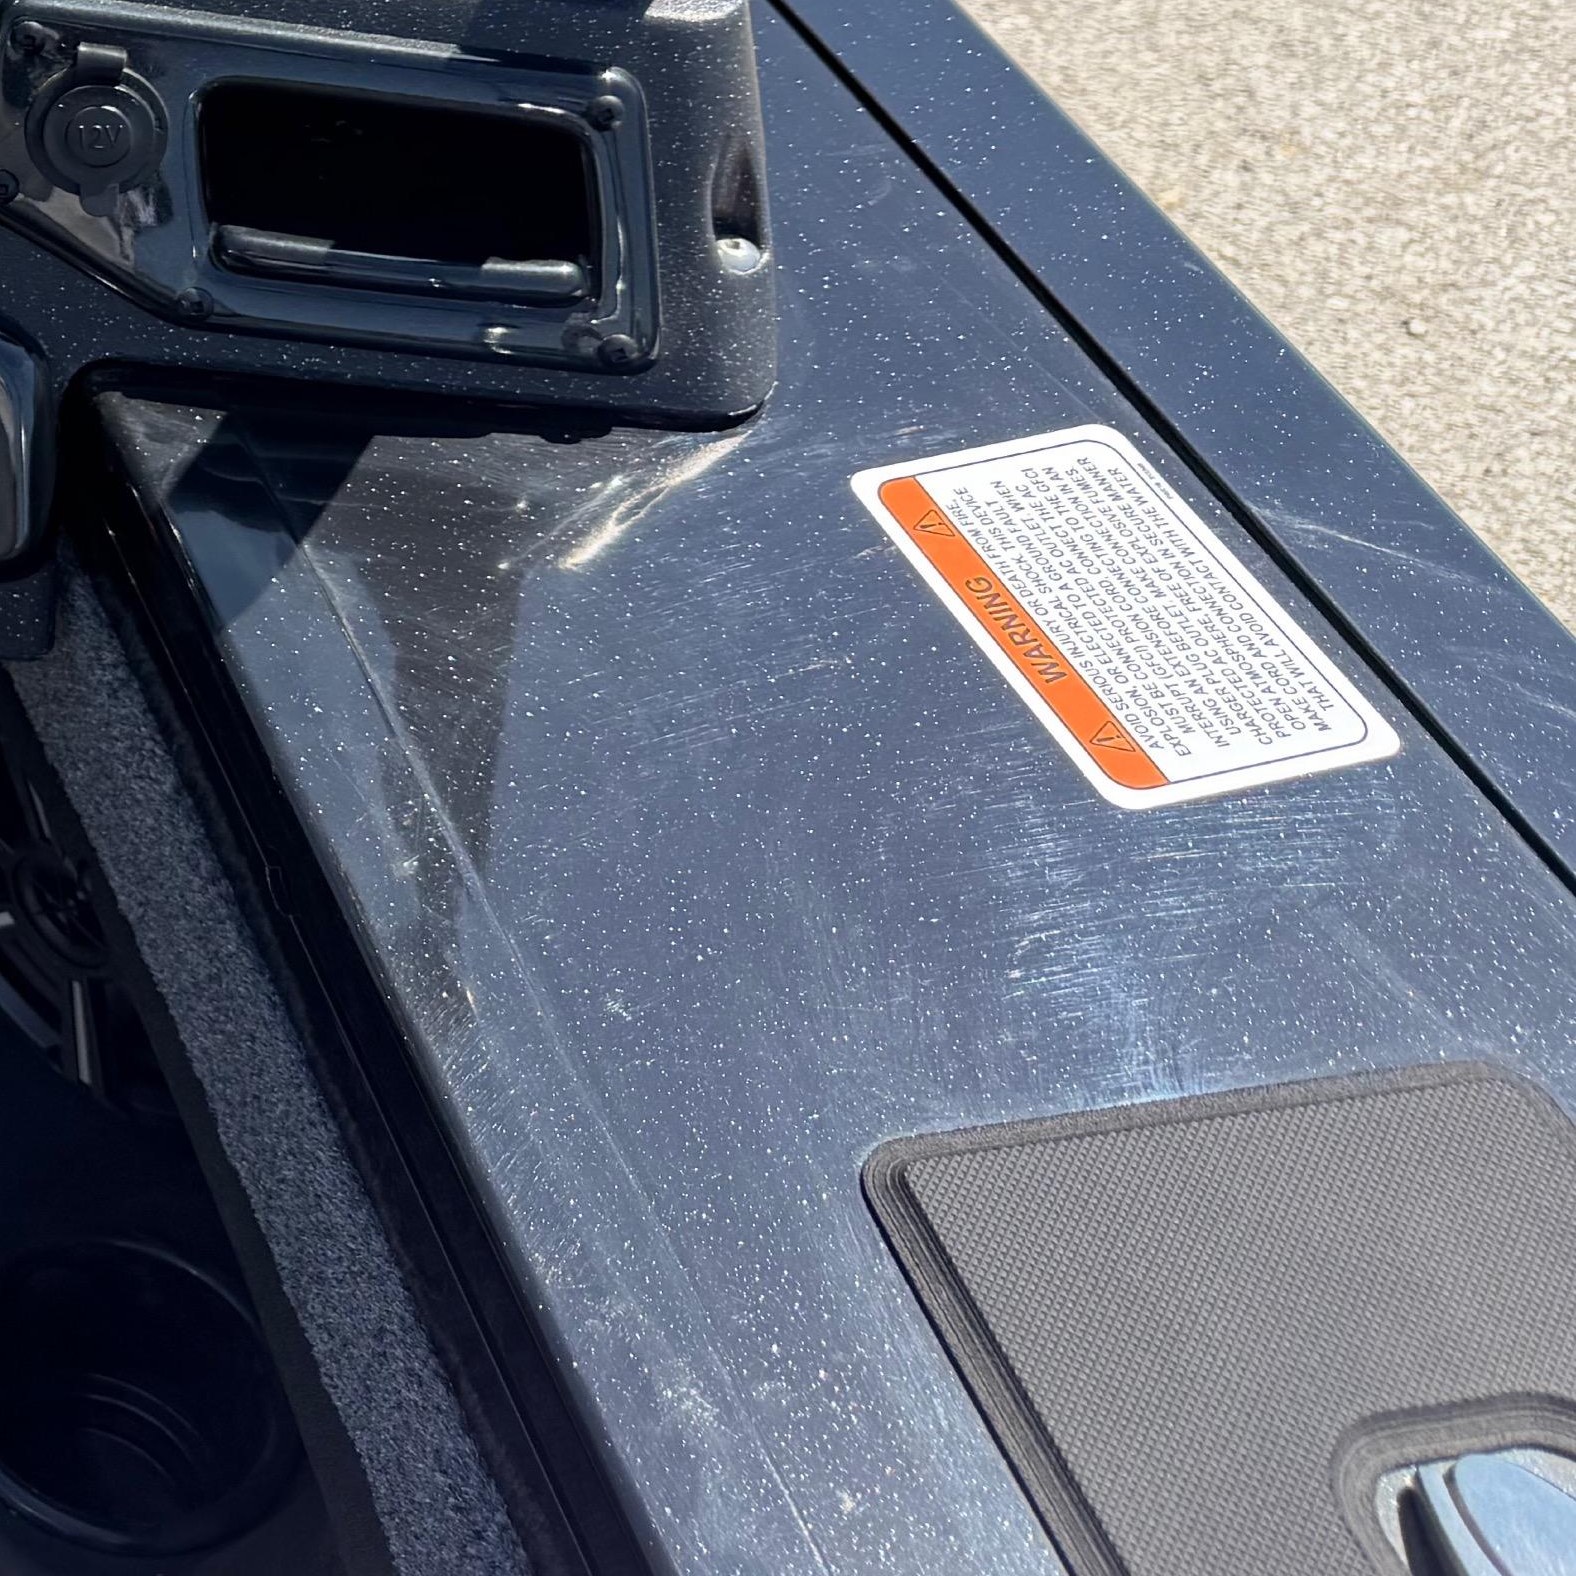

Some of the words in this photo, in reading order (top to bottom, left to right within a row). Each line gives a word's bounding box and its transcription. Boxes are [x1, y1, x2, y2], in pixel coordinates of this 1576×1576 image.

[78, 124, 124, 150] 12V
[1020, 467, 1050, 492] GFCI
[1041, 466, 1063, 480] AN
[1056, 483, 1074, 494] IN
[1076, 457, 1124, 501] MANNER
[1107, 467, 1148, 506] WATER
[953, 487, 994, 525] DEVICE
[990, 480, 1025, 512] WHEN
[1015, 484, 1036, 497] AC
[1044, 494, 1070, 516] THE
[985, 500, 1022, 533] FAULT
[1029, 500, 1054, 522] THE
[1064, 516, 1084, 532] TO
[1117, 503, 1163, 546] SECURE
[1141, 506, 1169, 528] THE
[966, 528, 1001, 558] FROM
[987, 526, 1015, 551] THIS
[1067, 496, 1136, 564] CONNECTION
[1097, 505, 1158, 564] EXPLOSIVE
[1162, 529, 1195, 557] WITH
[1015, 534, 1062, 581] GROUND
[1048, 524, 1101, 574] CONNECT
[1157, 548, 1175, 559] IN
[994, 560, 1034, 597] DEATH
[1058, 559, 1080, 574] AC
[1079, 533, 1148, 603] CONNECTING
[1129, 566, 1166, 598] MAKE
[1151, 567, 1172, 581] OF
[1057, 582, 1073, 590] A
[1066, 593, 1086, 609] TO
[1166, 582, 1202, 612] FREE
[1169, 561, 1241, 632] CONNECTION
[1188, 559, 1243, 610] CONTACT
[1026, 598, 1048, 616] OR
[1073, 577, 1140, 643] PROTECTED
[965, 576, 1067, 683] WARNING
[1042, 619, 1085, 658] INJURY
[1048, 595, 1113, 664] ELECTRICAL
[1081, 610, 1148, 679] CONNECTED
[1141, 605, 1191, 651] BEFORE
[1238, 612, 1279, 646] AVOID
[1126, 613, 1191, 677] EXTENSION
[1203, 649, 1227, 664] AC
[1236, 634, 1267, 657] AND
[1106, 666, 1129, 684] OR
[1133, 645, 1173, 679] (GFCI)
[1185, 653, 1221, 684] PLUG
[1260, 661, 1297, 694] CORD
[1274, 648, 1305, 678] WILL
[1078, 660, 1129, 710] SERIOUS
[1141, 682, 1165, 699] BE
[1183, 678, 1208, 694] AN
[1297, 681, 1334, 711] THAT
[1157, 702, 1195, 733] MUST
[1163, 683, 1230, 747] INTERRUPT
[1202, 698, 1241, 735] USING
[1214, 686, 1272, 744] CHARGER
[1220, 668, 1291, 737] PROTECTED
[1268, 697, 1306, 730] OPEN
[1291, 696, 1331, 731] MAKE
[1124, 713, 1164, 749] AVOID
